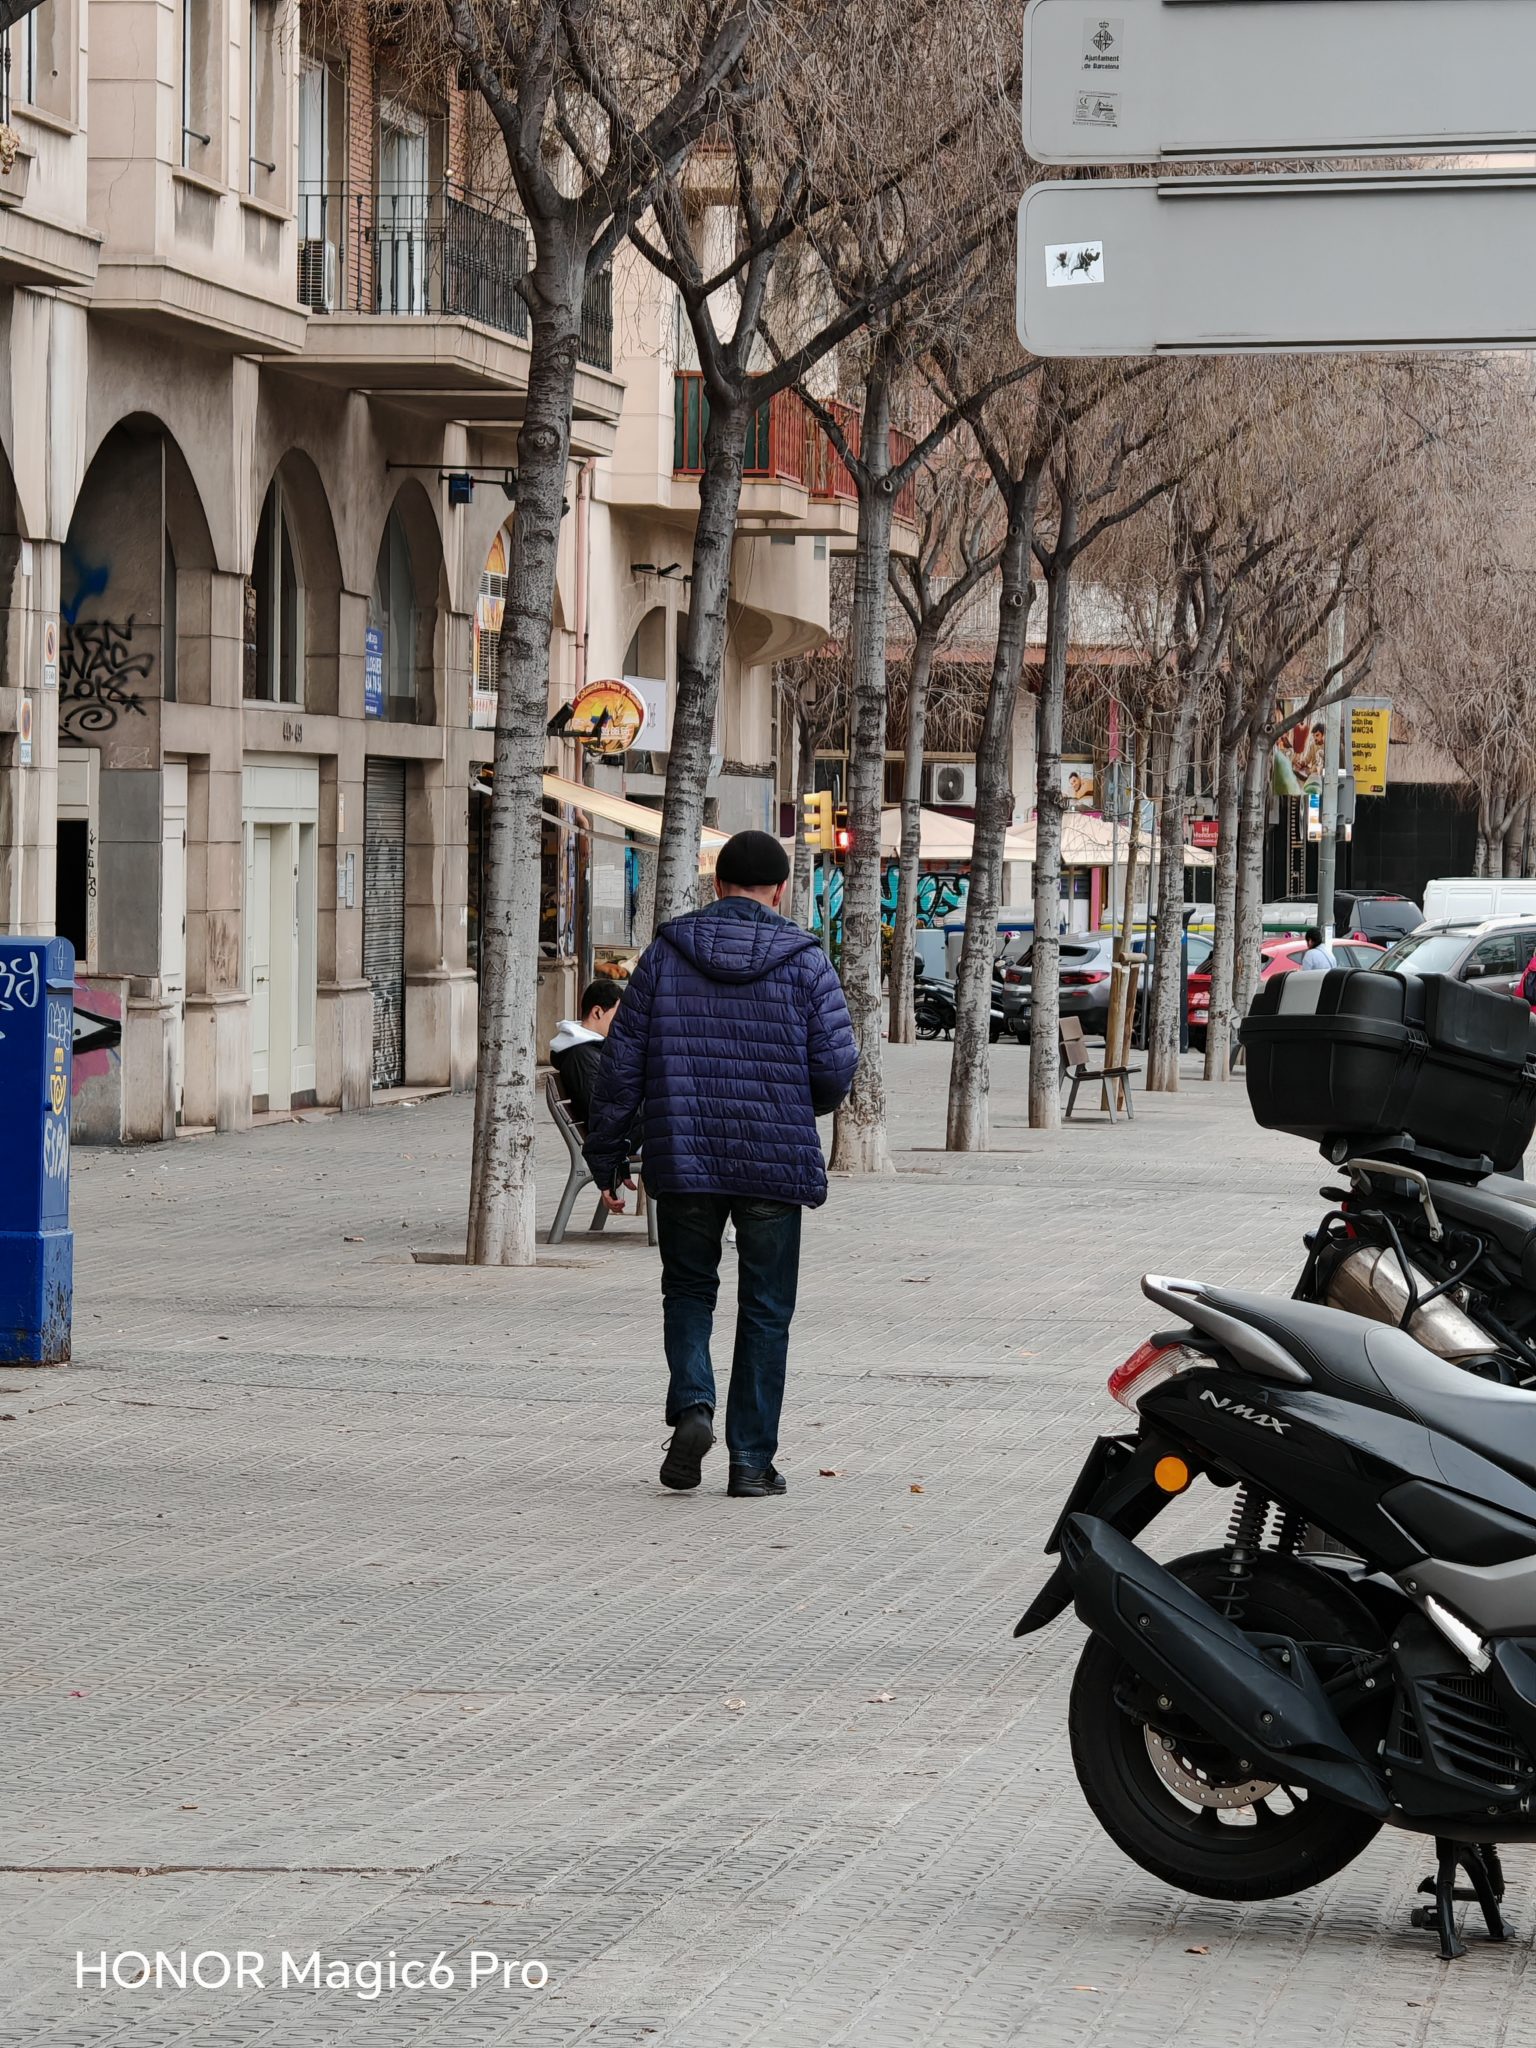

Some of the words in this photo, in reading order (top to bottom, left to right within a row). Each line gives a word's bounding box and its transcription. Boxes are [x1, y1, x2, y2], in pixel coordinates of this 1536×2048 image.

[1084, 54, 1119, 62] Ajuntament
[1352, 709, 1380, 717] Barcelona
[1199, 1389, 1292, 1435] NMAX
